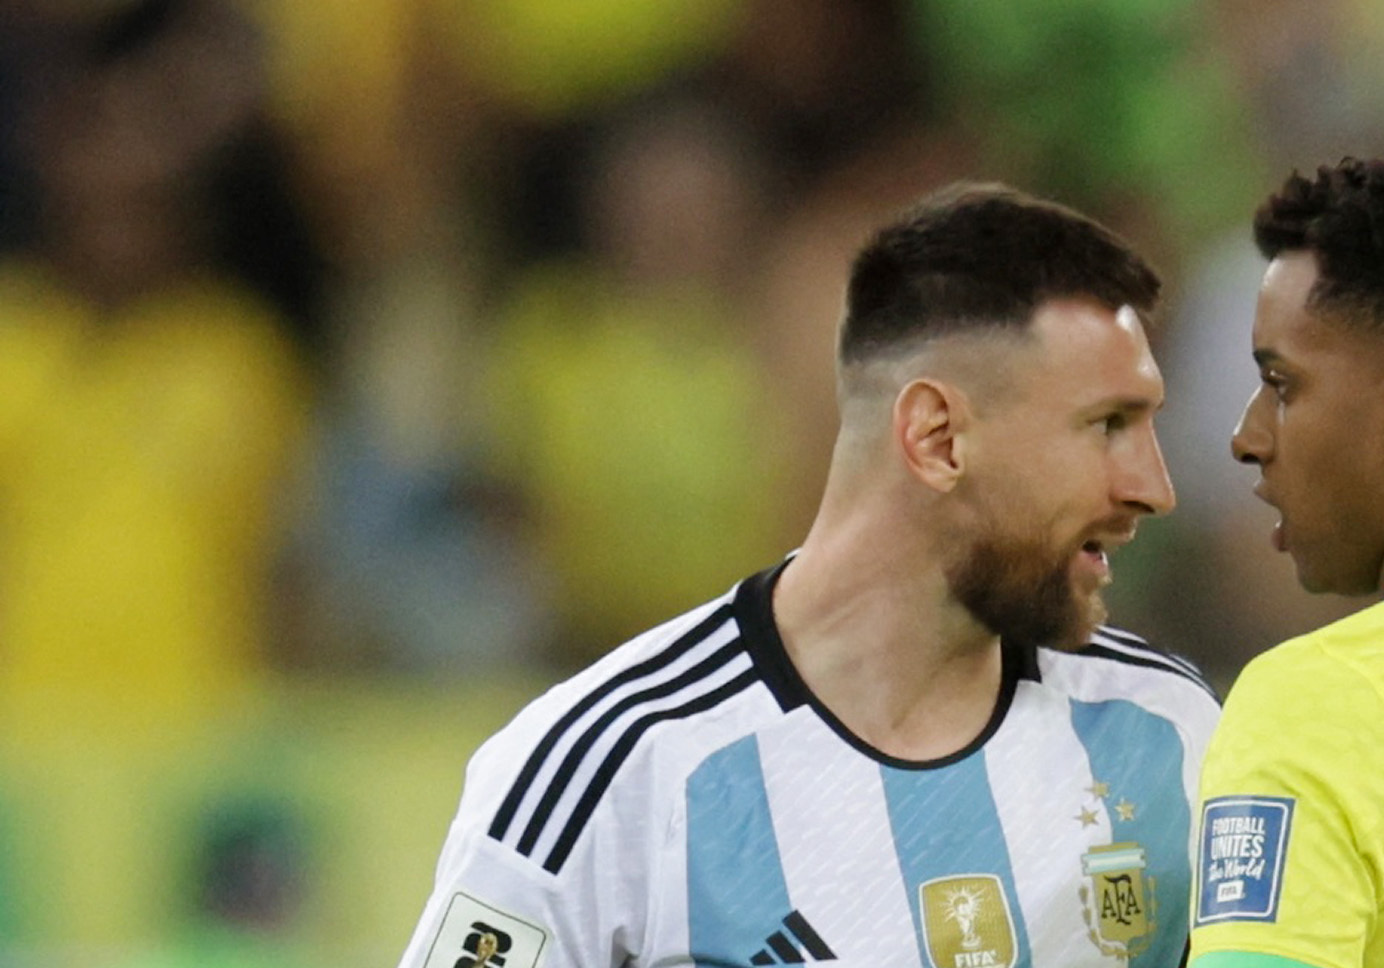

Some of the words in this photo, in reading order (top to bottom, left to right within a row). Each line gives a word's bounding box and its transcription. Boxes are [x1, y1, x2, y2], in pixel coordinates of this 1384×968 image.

[1210, 835, 1264, 860] UNITES
[1101, 873, 1141, 925] AFA
[954, 950, 996, 968] FIFA
